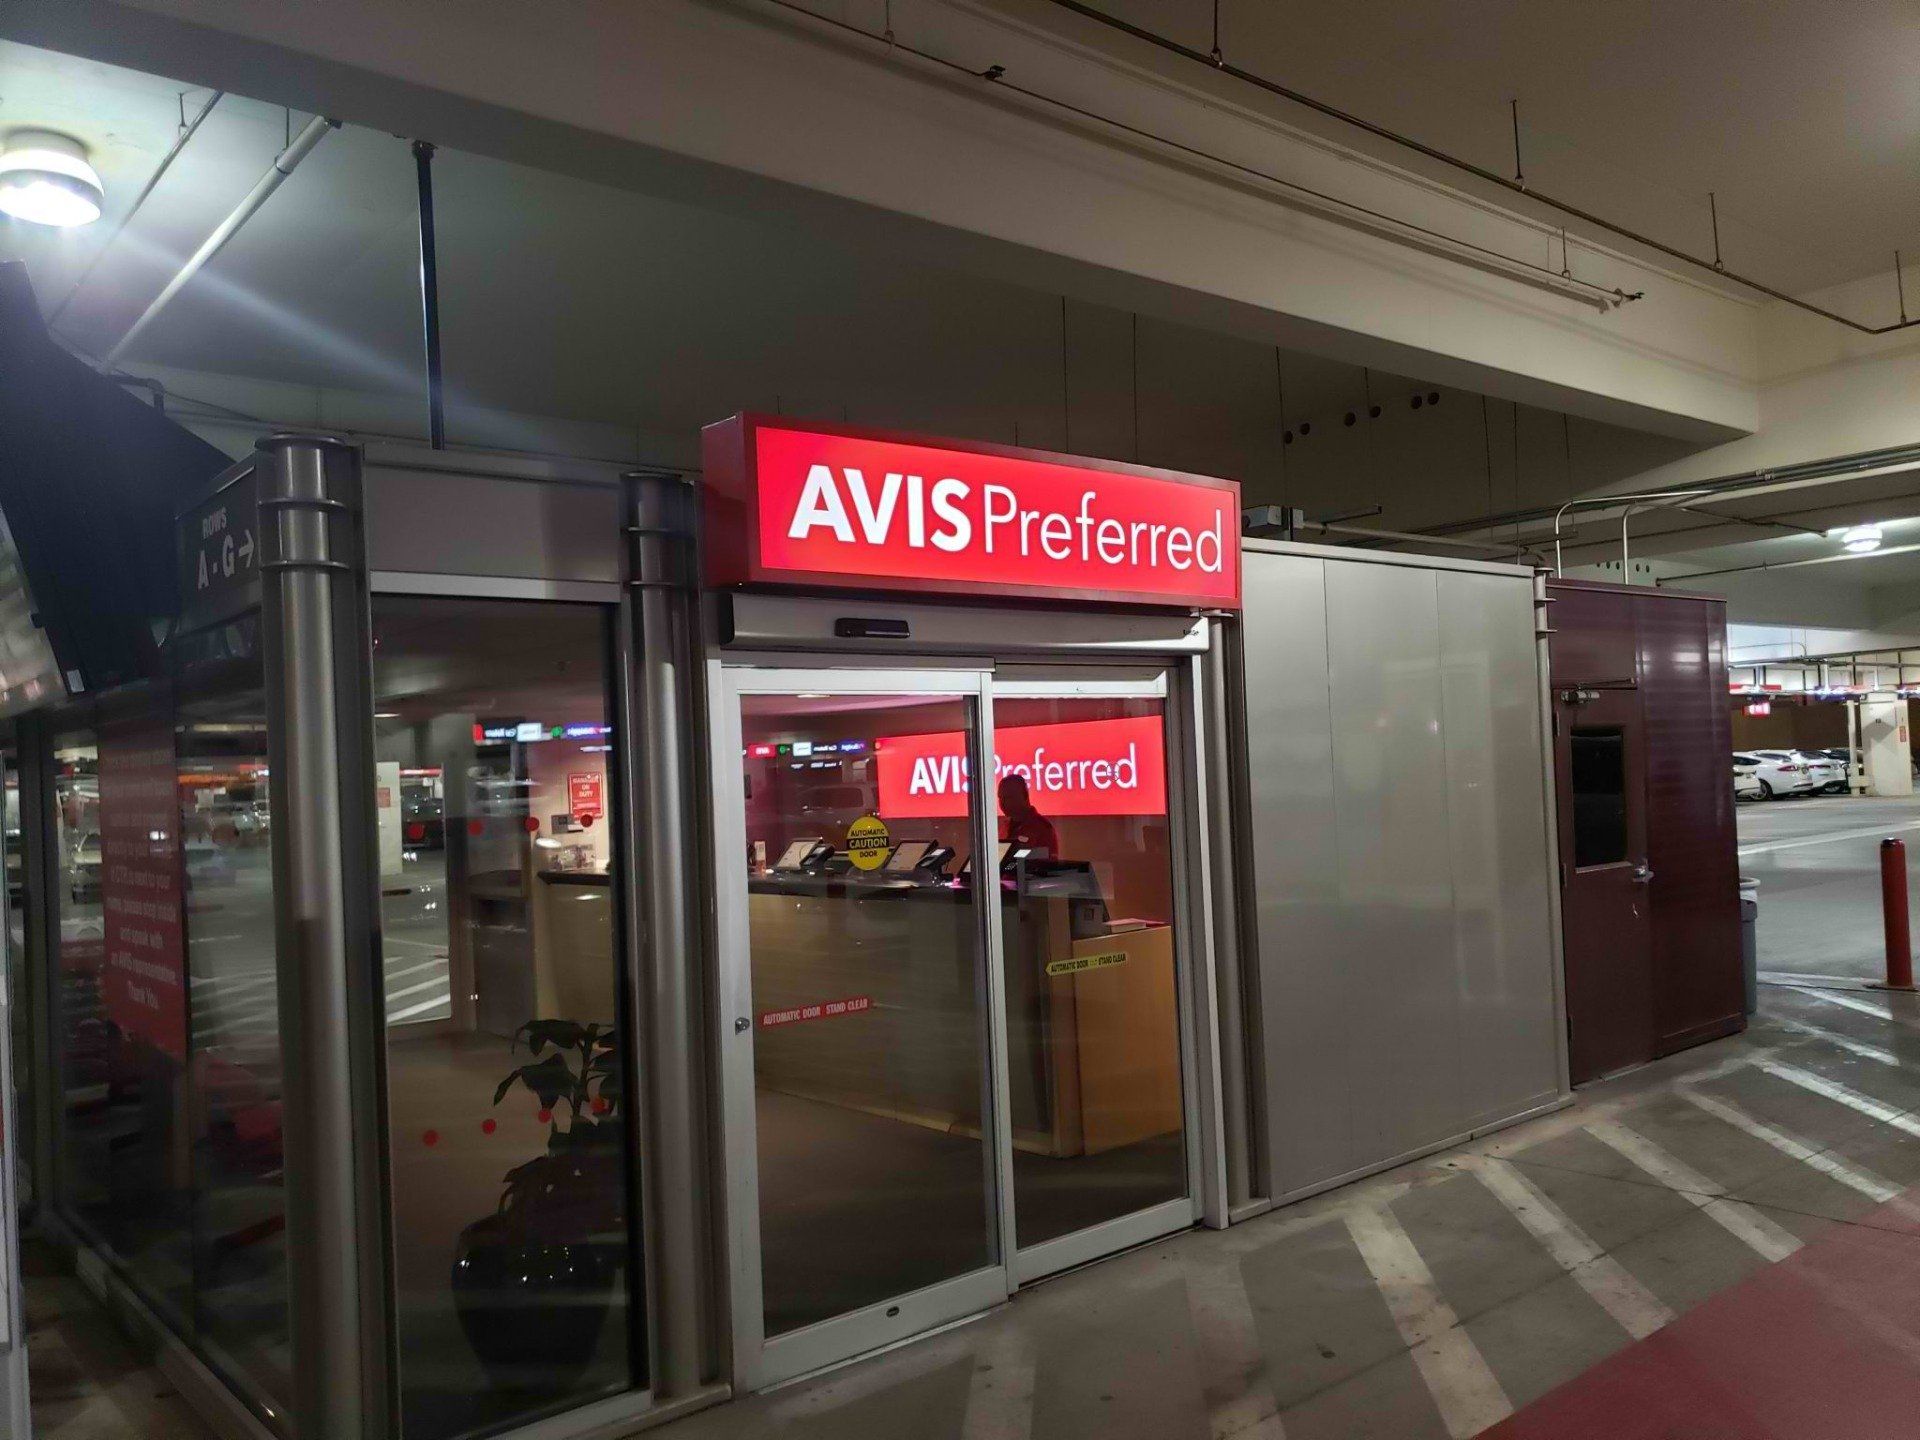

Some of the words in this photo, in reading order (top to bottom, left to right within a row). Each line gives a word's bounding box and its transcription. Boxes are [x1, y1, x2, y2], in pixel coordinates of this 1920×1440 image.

[788, 464, 972, 552] AVIS
[985, 484, 1222, 573] Preferred
[197, 549, 210, 589] A
[222, 534, 235, 578] G
[850, 829, 885, 837] AUTOMATIC
[849, 837, 887, 848] CAUTION
[860, 850, 878, 858] DOOR
[1076, 959, 1089, 970] DOOR
[1098, 955, 1112, 966] STAND
[763, 1009, 800, 1025] AUTOMATIC
[802, 1006, 821, 1019] DOOR
[825, 1002, 846, 1014] STAND
[847, 998, 868, 1011] CLEAR
